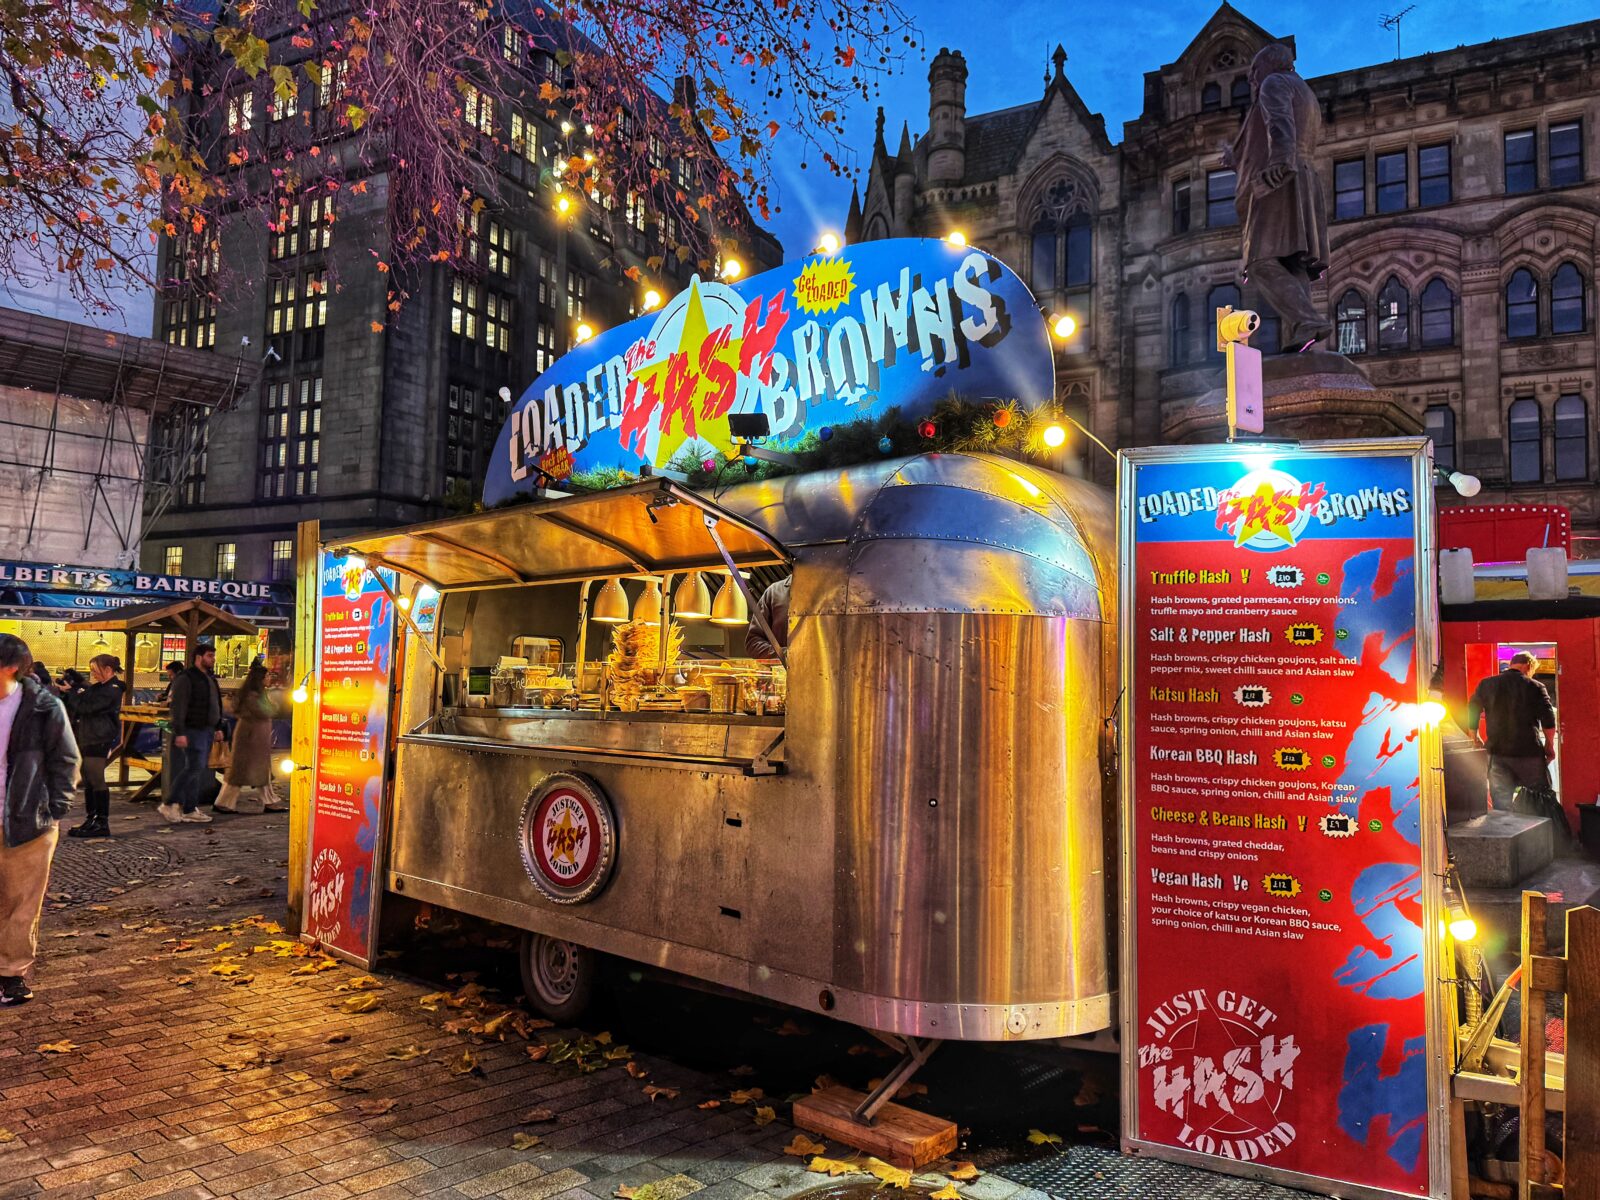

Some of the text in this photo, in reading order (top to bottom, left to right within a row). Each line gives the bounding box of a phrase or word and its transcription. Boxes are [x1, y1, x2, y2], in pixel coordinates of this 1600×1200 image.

[798, 273, 816, 293] Get
[807, 279, 848, 303] LOADED
[509, 354, 633, 482] LOADED
[618, 288, 790, 461] HASH
[757, 252, 999, 437] BROWNS
[1138, 486, 1219, 524] LOADED
[1216, 482, 1328, 536] HASH
[1317, 486, 1410, 525] BROWNS
[136, 574, 272, 598] BARBEQUE
[1150, 570, 1196, 584] Truffle
[1199, 569, 1230, 584] Hash
[75, 597, 96, 606] ON
[1211, 596, 1242, 605] grated
[1293, 596, 1321, 605] crispy
[1322, 596, 1358, 606] onions,
[1150, 607, 1178, 615] truffle
[1224, 607, 1270, 616] cranberry
[1150, 627, 1270, 643] Salt & Pepper Hash
[1174, 654, 1210, 662] browns,
[1211, 655, 1239, 664] crispy
[1240, 655, 1276, 663] chicken
[1277, 656, 1318, 665] goujons,
[1319, 656, 1337, 664] salt
[1338, 656, 1357, 665] and
[1184, 666, 1204, 674] mix,
[1233, 666, 1255, 674] chilli
[1285, 667, 1304, 675] and
[1305, 667, 1331, 676] Asian
[1333, 668, 1355, 677] slaw
[1150, 687, 1219, 702] Katsu Hash
[1174, 714, 1210, 723] browns,
[1211, 716, 1239, 725] crispy
[1240, 716, 1276, 725] chicken
[1277, 719, 1319, 728] goujons,
[1320, 719, 1347, 728] katsu
[1179, 727, 1208, 736] spring
[1209, 727, 1239, 736] onion,
[1240, 728, 1263, 736] chilli
[1264, 729, 1283, 737] and
[1284, 729, 1311, 738] Asian
[1312, 730, 1334, 739] slaw
[1150, 746, 1257, 765] Korean BBQ Hash
[1151, 773, 1356, 792] Hash browns, crispy chicken goujons, Korean
[1151, 784, 1170, 793] BBQ
[1201, 788, 1230, 798] spring
[1231, 790, 1261, 798] onion,
[1263, 791, 1285, 799] chilli
[1287, 792, 1305, 801] and
[1307, 793, 1334, 802] Asian
[1334, 794, 1358, 804] slaw
[552, 798, 585, 820] JUST GET
[1151, 807, 1195, 822] Cheese
[1199, 810, 1208, 826] &
[1212, 812, 1251, 827] Beans
[1254, 814, 1286, 829] Hash
[1329, 820, 1340, 828] £9
[546, 824, 588, 854] HASH
[1151, 833, 1285, 851] Hash browns, grated cheddar,
[313, 848, 342, 878] JUST GET
[1151, 845, 1178, 854] beans
[1198, 850, 1226, 860] crispy
[1227, 852, 1259, 861] onions
[549, 854, 580, 876] LOADED
[1151, 868, 1188, 885] Vegan
[1192, 873, 1222, 888] Hash
[1273, 881, 1287, 889] £12
[312, 872, 344, 922] HASH
[1151, 893, 1311, 916] Hash browns, crispy vegan chicken,
[1151, 918, 1304, 940] spring onion, chilli and Asian slaw
[1173, 908, 1202, 917] choice
[1203, 910, 1214, 918] of
[1215, 911, 1240, 921] katsu
[1254, 916, 1287, 926] Korean
[1289, 918, 1310, 929] BBQ
[1311, 922, 1342, 932] sauce,
[1146, 988, 1278, 1039] JUST GET
[1152, 1034, 1302, 1120] HASH
[1176, 1121, 1297, 1162] LOADED
